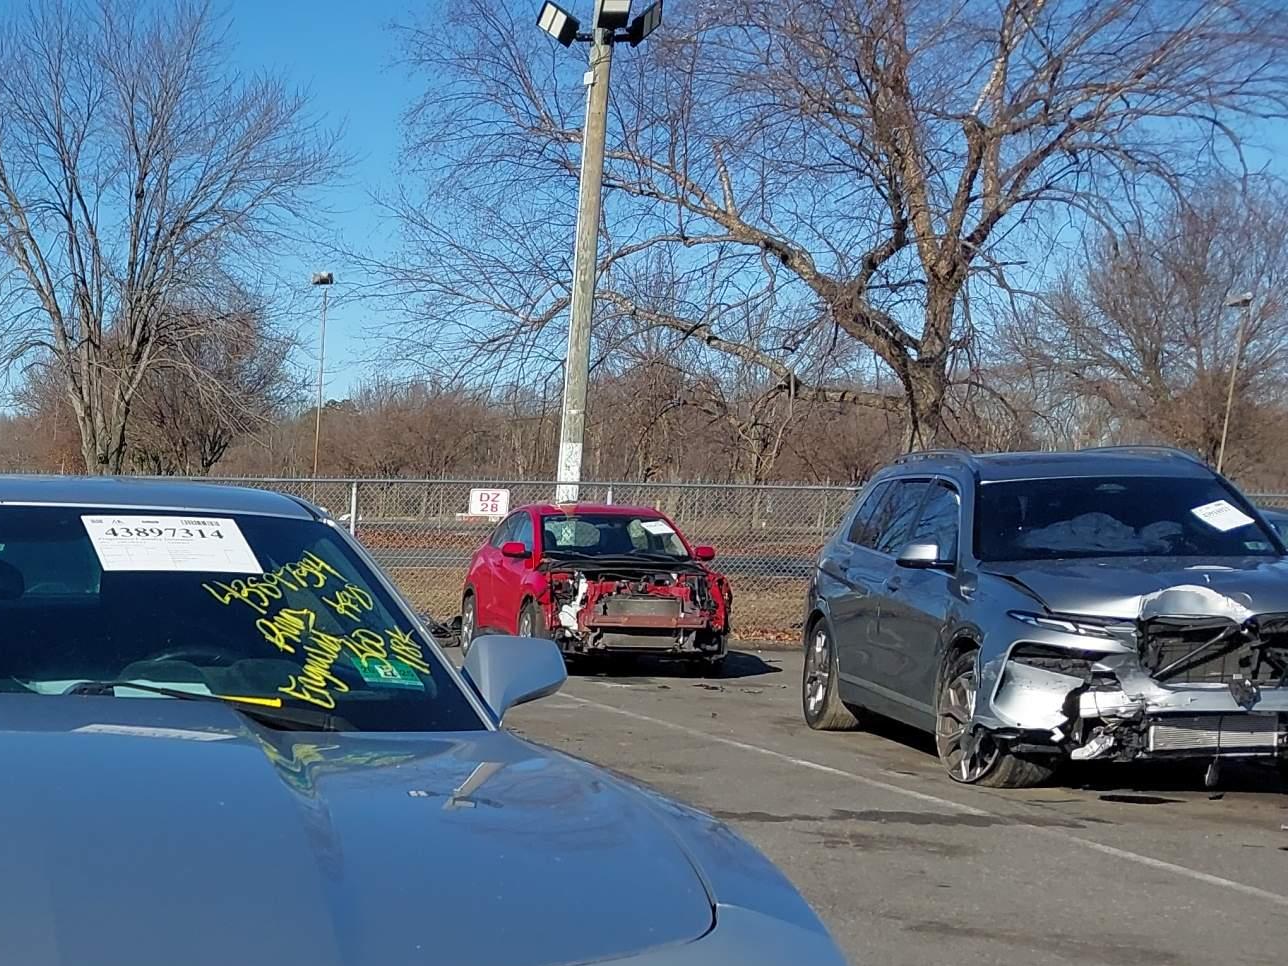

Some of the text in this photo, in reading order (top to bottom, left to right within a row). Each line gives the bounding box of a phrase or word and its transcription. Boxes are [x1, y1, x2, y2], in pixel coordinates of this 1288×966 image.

[479, 492, 500, 502] DZ
[479, 502, 498, 512] 28
[105, 527, 224, 539] 43897314
